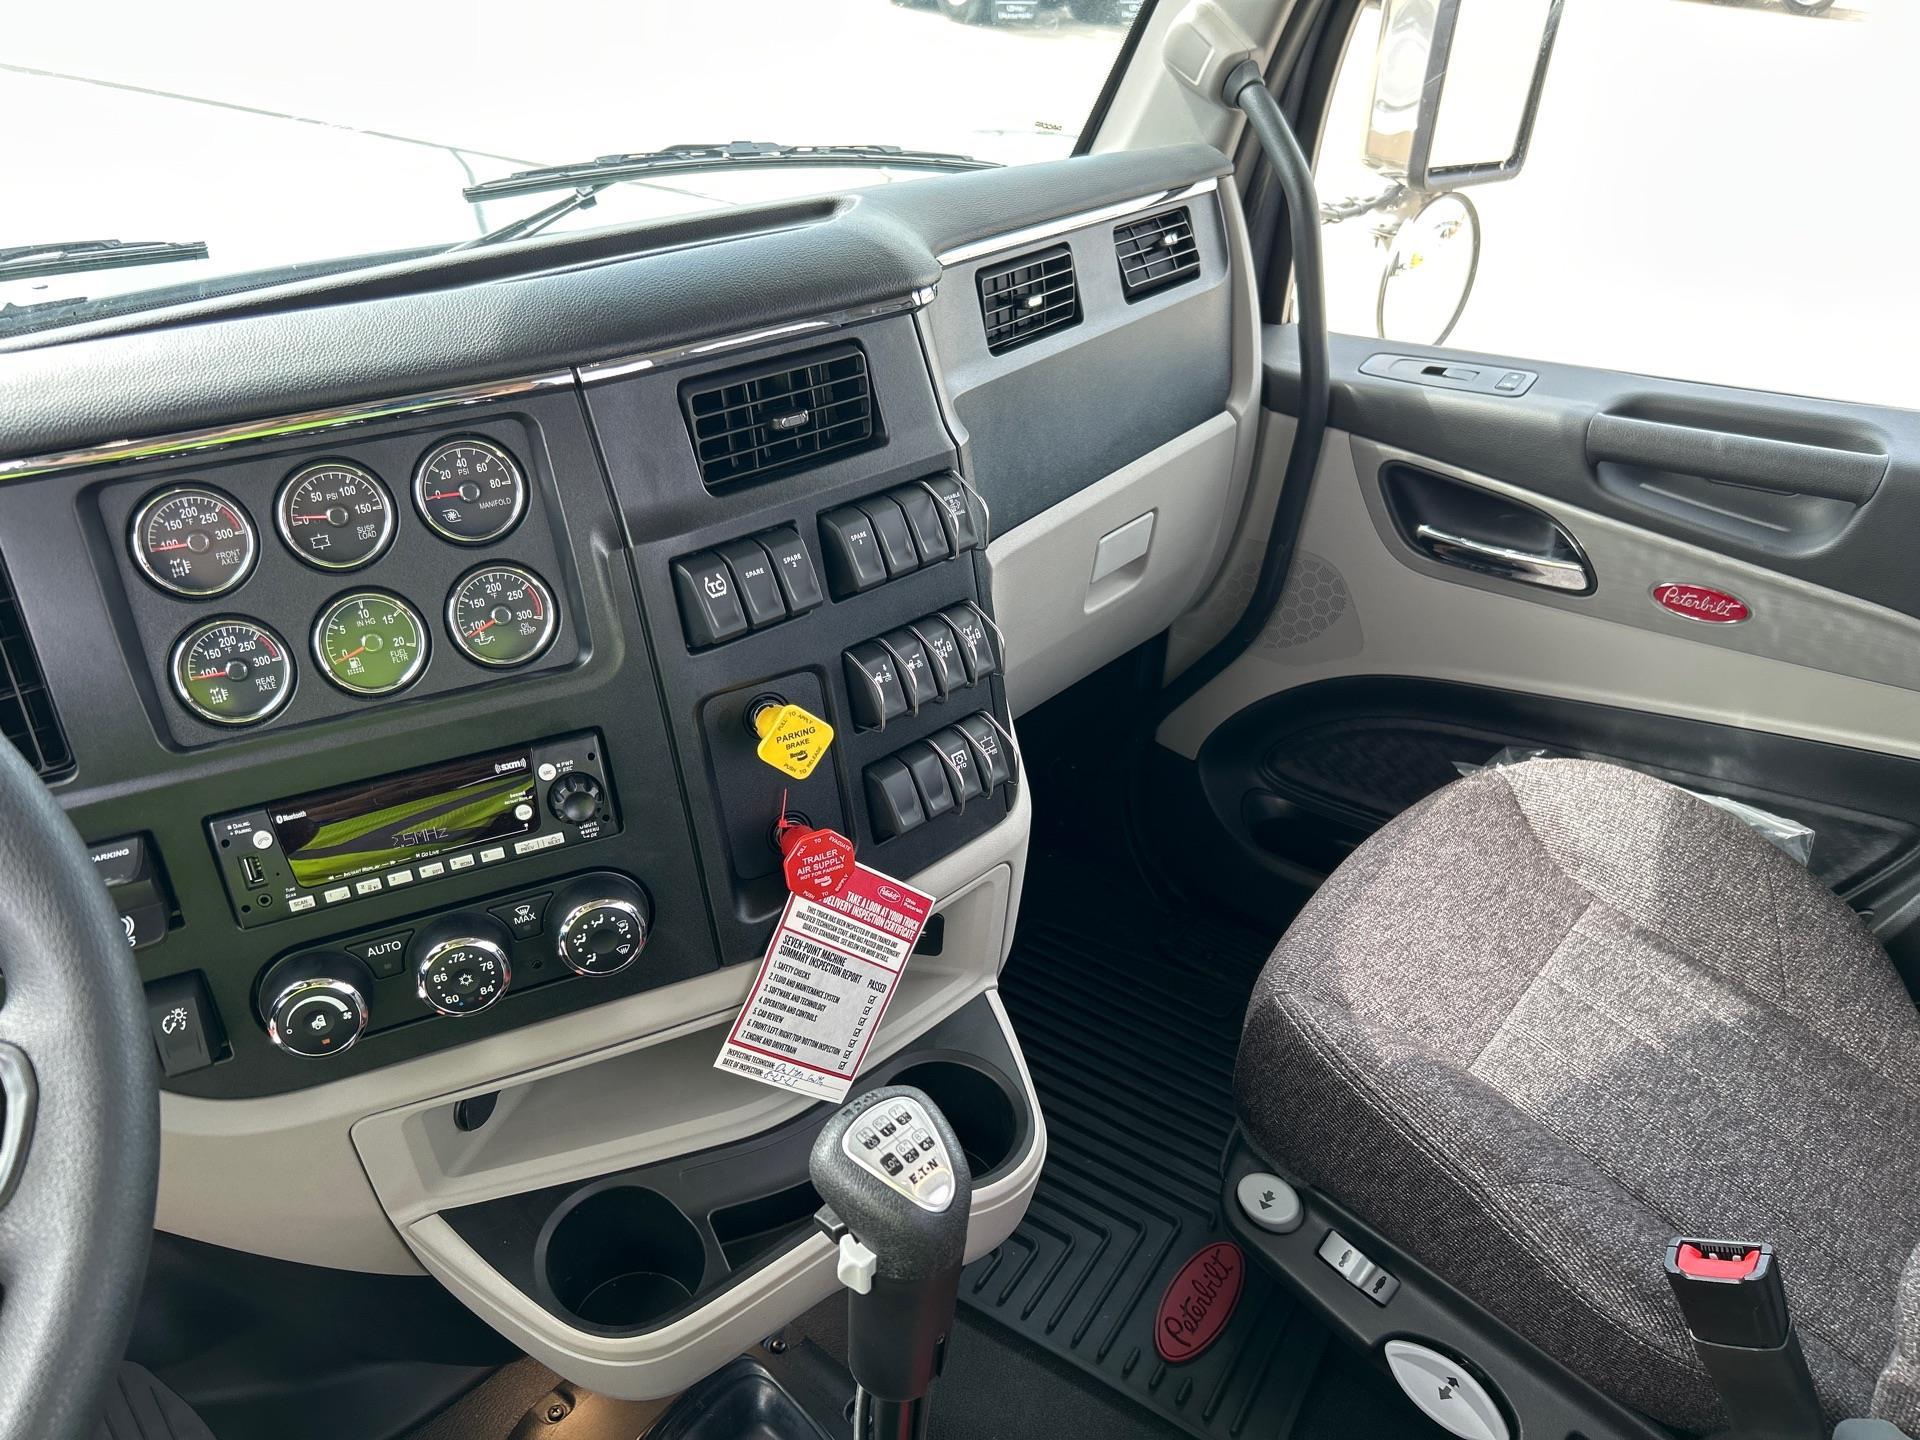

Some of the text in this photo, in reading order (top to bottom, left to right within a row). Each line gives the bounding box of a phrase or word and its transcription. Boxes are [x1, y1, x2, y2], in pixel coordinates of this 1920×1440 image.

[456, 458, 467, 468] 40
[476, 463, 487, 473] 60
[440, 470, 451, 480] 20
[489, 479, 501, 489] 80
[311, 492, 322, 502] 50
[340, 486, 356, 496] 100
[355, 503, 371, 514] 150
[479, 498, 511, 510] MANIFOLD
[180, 506, 198, 519] 200
[200, 513, 218, 524] 250
[165, 519, 182, 531] 150
[357, 524, 375, 534] SUSP
[215, 528, 233, 540] 300
[359, 530, 376, 540] LOAD
[851, 531, 867, 541] SPARE
[216, 549, 240, 560] FRONT
[783, 553, 801, 564] SPARE
[222, 556, 240, 566] AXLE
[745, 567, 764, 578] SPARE
[485, 582, 502, 593] 200
[708, 580, 724, 592] TC
[507, 590, 523, 601] 250
[1663, 587, 1739, 615] Peterbilt
[469, 598, 485, 608] 150
[358, 609, 370, 619] 10
[383, 615, 394, 624] 15
[516, 610, 532, 621] 300
[340, 625, 346, 635] 5
[470, 620, 485, 631] 100
[520, 627, 536, 636] TEMP
[219, 636, 236, 648] 200
[238, 640, 256, 652] 250
[393, 636, 405, 646] 20
[204, 649, 221, 660] 150
[390, 649, 408, 658] FUEL
[392, 655, 409, 663] FLTR
[253, 655, 270, 667] 300
[256, 675, 275, 686] REAR
[259, 682, 276, 692] AXLE
[777, 719, 787, 731] PULL
[797, 714, 814, 724] APPLY
[776, 726, 816, 744] PARKING
[785, 738, 810, 750] BRAKE
[784, 763, 797, 773] PUSH
[806, 747, 822, 769] RELEASE
[283, 811, 306, 821] Bluetooth
[797, 844, 807, 857] PULL
[829, 836, 851, 850] EVACUATE
[92, 848, 129, 862] ARKING
[802, 849, 838, 866] TRAILER
[797, 855, 846, 875] AIR SUPPLY
[800, 864, 844, 881] NOT FOR PARKING
[803, 890, 815, 900] PUSH
[835, 874, 849, 892] SUPPLY
[823, 894, 914, 939] DELIVERY INSPECTION CERTIFICATE
[845, 891, 919, 930] TAKE A LOOK AT YOUR TRUCK
[513, 912, 536, 925] MAX
[845, 922, 865, 934] INSPECTED
[367, 941, 401, 957] AUTO
[782, 935, 846, 966] SEVEN-POINT MACHINE
[452, 952, 466, 963] 72
[480, 960, 494, 972] 78
[778, 945, 861, 983] SUMMARY INSPECTION REPORT
[777, 962, 793, 973] SAFETY
[793, 968, 810, 979] CHECKS
[433, 972, 448, 983] 66
[480, 984, 494, 995] 84
[773, 974, 786, 983] FLUID
[785, 979, 795, 987] AND
[794, 982, 824, 997] MAINTENANCE
[823, 993, 840, 1003] SYSTEM
[867, 979, 886, 993] PASSED
[445, 994, 460, 1005] 60
[768, 986, 791, 999] SOFTWARE
[790, 994, 800, 1002] AND
[799, 997, 826, 1011] TECHNOLOGY
[762, 997, 787, 1010] OPERATION
[786, 1006, 796, 1014] AND
[795, 1009, 817, 1021] CONTROLS
[757, 1009, 767, 1017] CAB
[766, 1013, 783, 1023] REVIEW
[745, 1032, 762, 1042] ENGINE
[771, 1041, 797, 1054] DRIVETRAIN
[817, 1043, 840, 1055] INSPECTION
[726, 1049, 751, 1060] INSPECTING
[722, 1058, 733, 1066] DATE
[738, 1063, 763, 1075] INSPECTION:
[1164, 1249, 1233, 1346] Peterbilt
